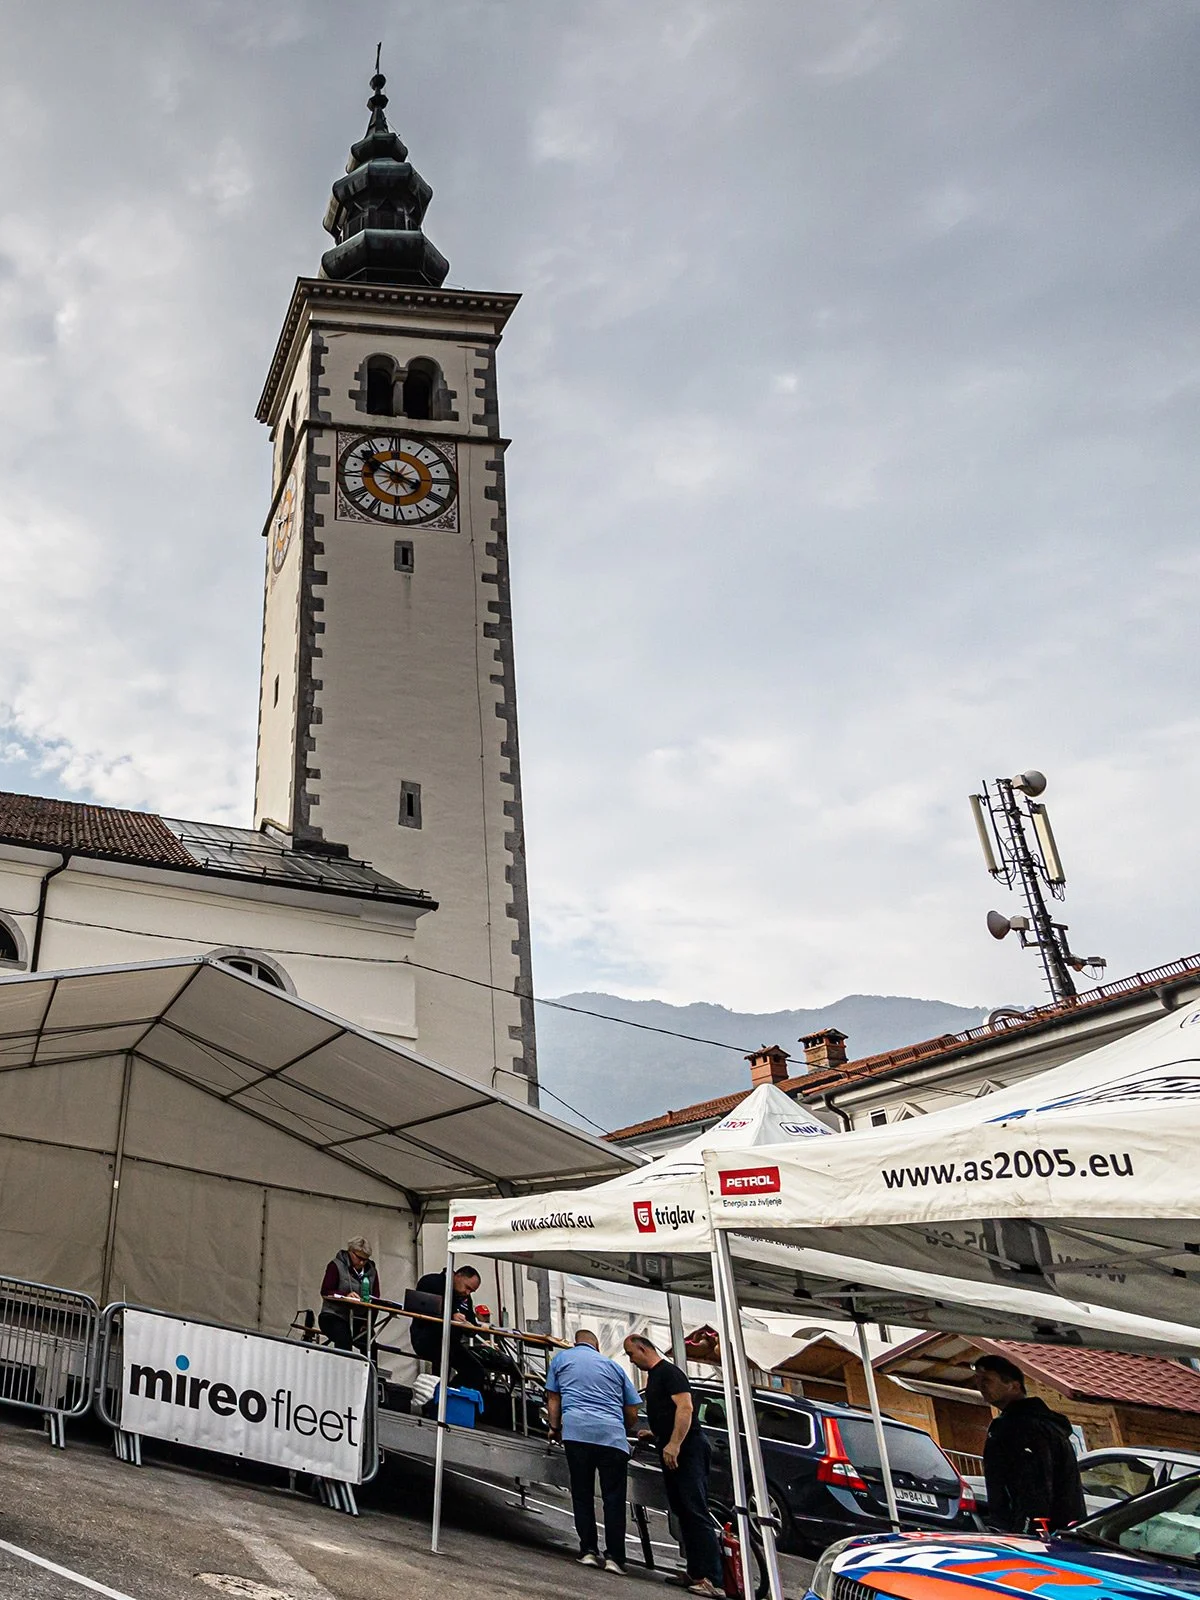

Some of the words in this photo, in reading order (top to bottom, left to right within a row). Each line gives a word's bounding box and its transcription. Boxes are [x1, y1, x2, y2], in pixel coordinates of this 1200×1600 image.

[727, 1175, 774, 1188] PETROL
[882, 1148, 1134, 1190] www.as2005.eu
[511, 1212, 595, 1231] www.as2005.eu
[655, 1206, 695, 1232] triglav
[129, 1354, 267, 1423] mireo
[271, 1389, 358, 1447] fleet
